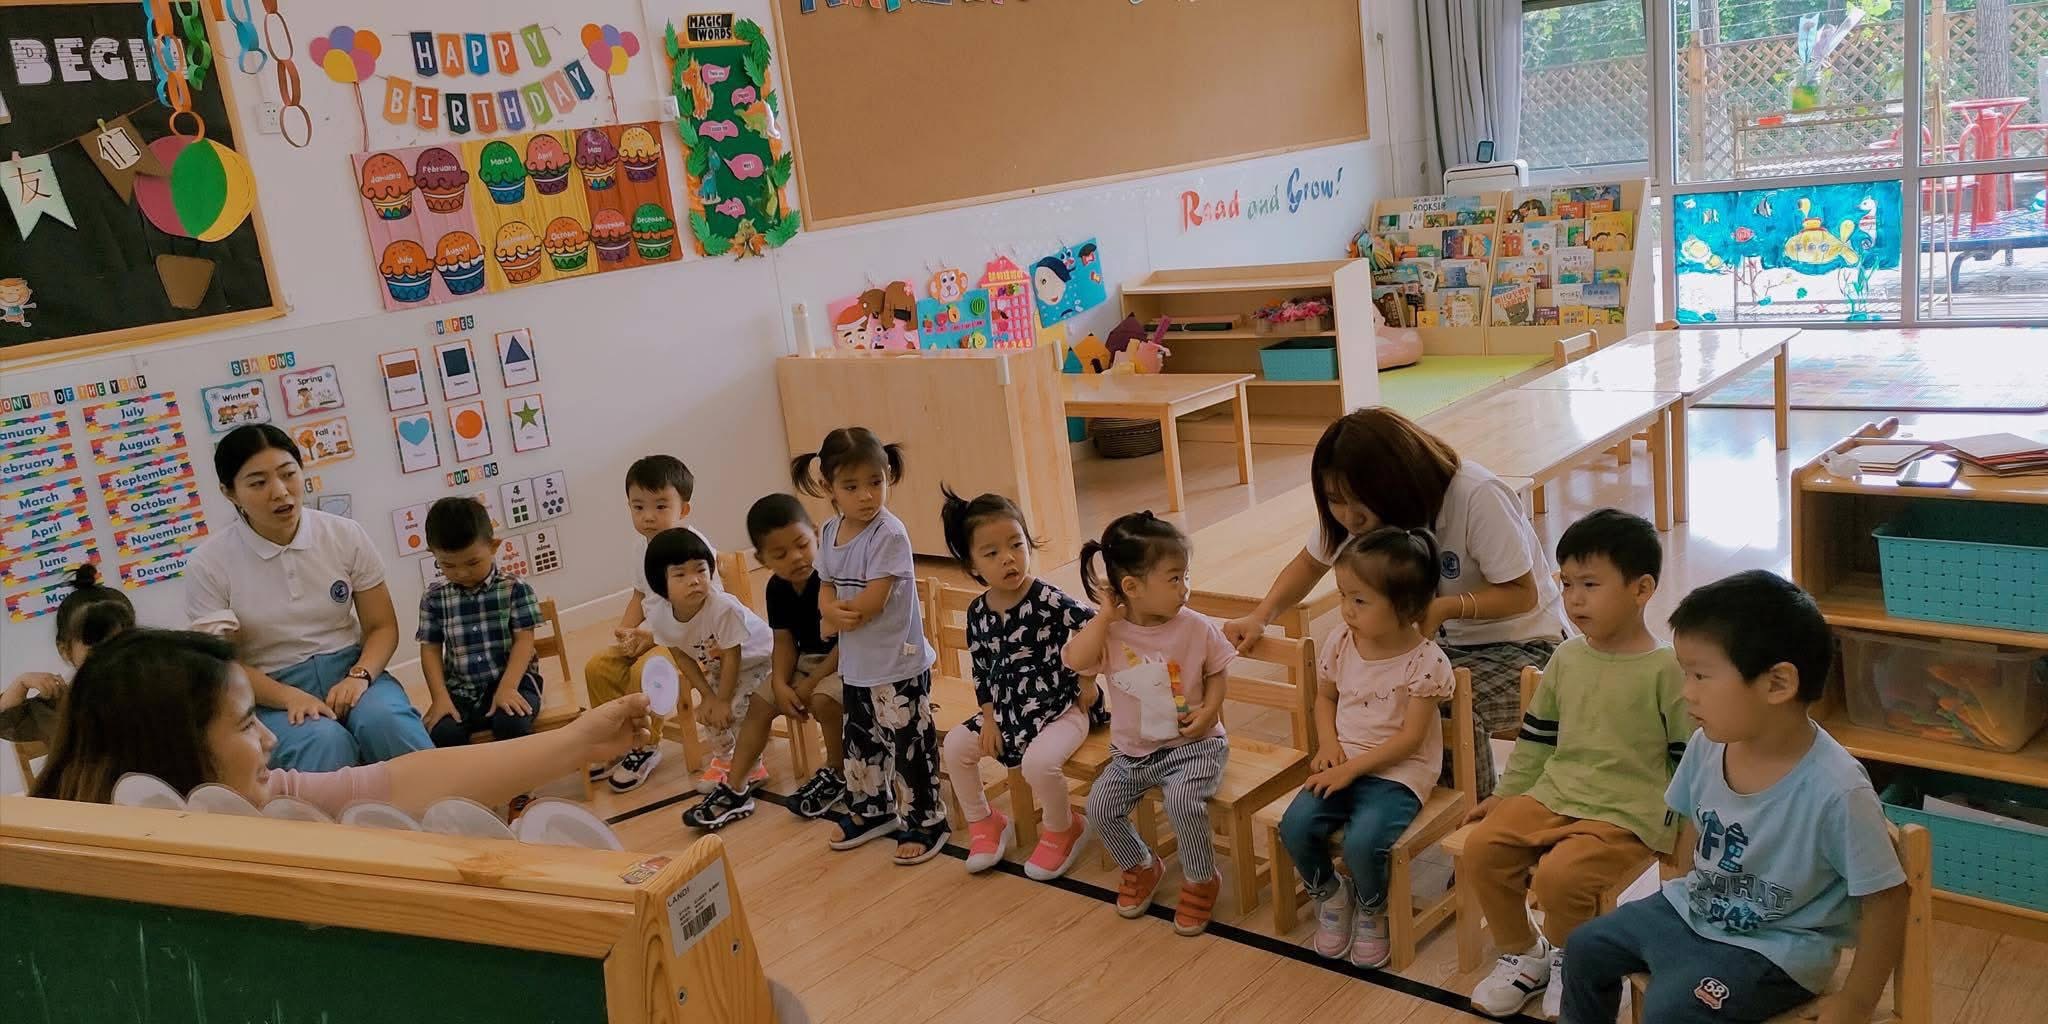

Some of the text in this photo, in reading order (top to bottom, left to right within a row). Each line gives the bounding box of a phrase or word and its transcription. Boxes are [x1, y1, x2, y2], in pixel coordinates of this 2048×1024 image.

[689, 15, 722, 28] MAGIC
[698, 28, 732, 41] WORDS
[417, 30, 545, 71] HAPPY
[390, 68, 587, 126] BIRTHDAY
[490, 158, 513, 167] March
[8, 167, 52, 205] 友
[1247, 184, 1280, 220] and
[1286, 167, 1343, 214] Grow!
[297, 376, 323, 386] Spring
[54, 388, 74, 404] OF
[78, 380, 106, 399] THE
[110, 375, 147, 393] YEAR
[222, 393, 250, 402] Winter
[121, 407, 144, 419] July
[0, 425, 46, 440] anuary
[316, 429, 329, 437] Fall
[119, 437, 161, 452] August
[116, 465, 178, 487] September
[447, 463, 499, 486] NUMBERS
[513, 485, 521, 495] 4
[546, 478, 554, 488] 5
[19, 493, 59, 510] March
[131, 496, 177, 512] October
[406, 511, 414, 521] 1
[31, 523, 62, 539] April
[132, 525, 192, 545] November
[538, 533, 545, 543] 9
[505, 542, 513, 552] 8
[39, 557, 68, 570] June
[137, 560, 188, 578] Decemb
[1704, 981, 1724, 997] 58
